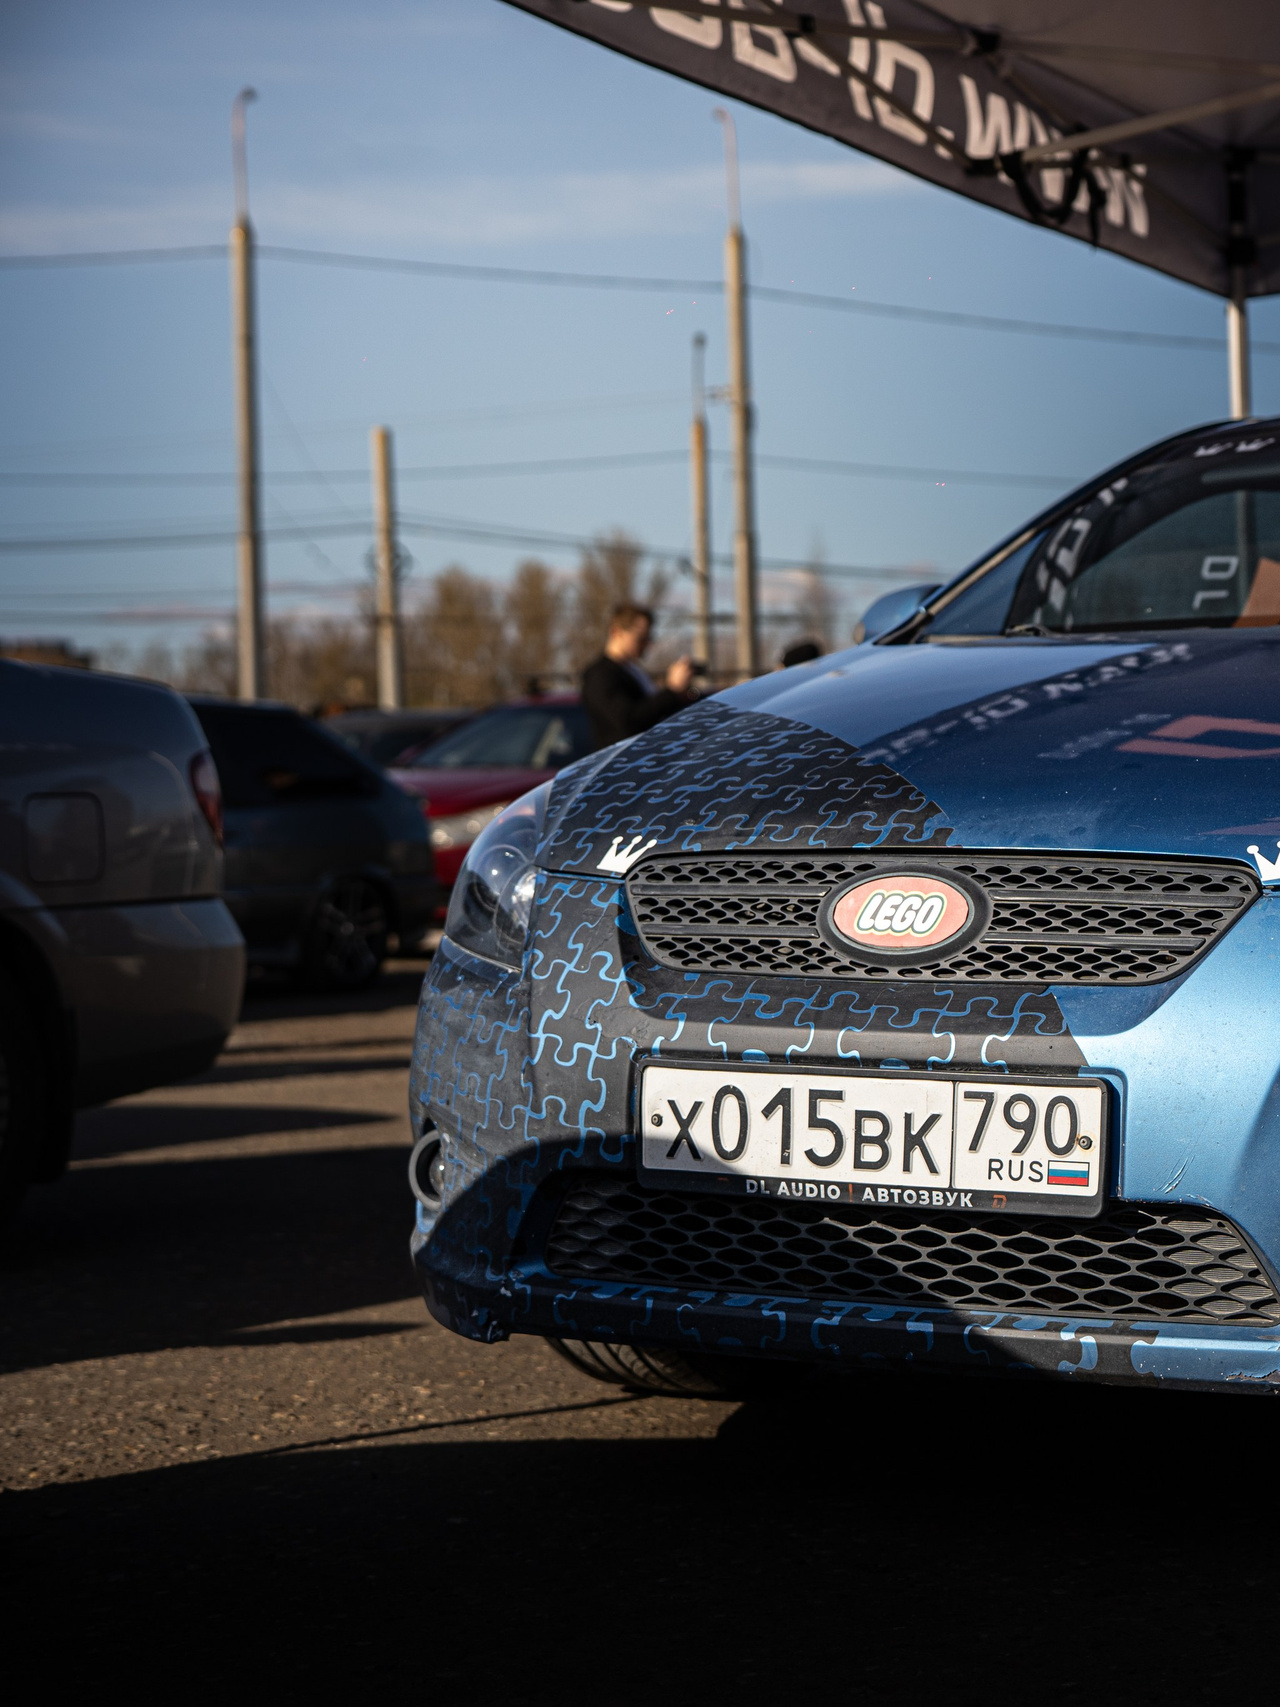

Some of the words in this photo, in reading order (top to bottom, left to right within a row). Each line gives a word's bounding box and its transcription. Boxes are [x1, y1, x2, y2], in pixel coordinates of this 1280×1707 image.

[858, 893, 945, 932] LEGO
[963, 1090, 1078, 1157] 790
[988, 1159, 1043, 1183] RUS
[745, 1178, 770, 1196] DL
[777, 1181, 841, 1200] AUDIO
[862, 1187, 973, 1208] АВТОЗВУК
